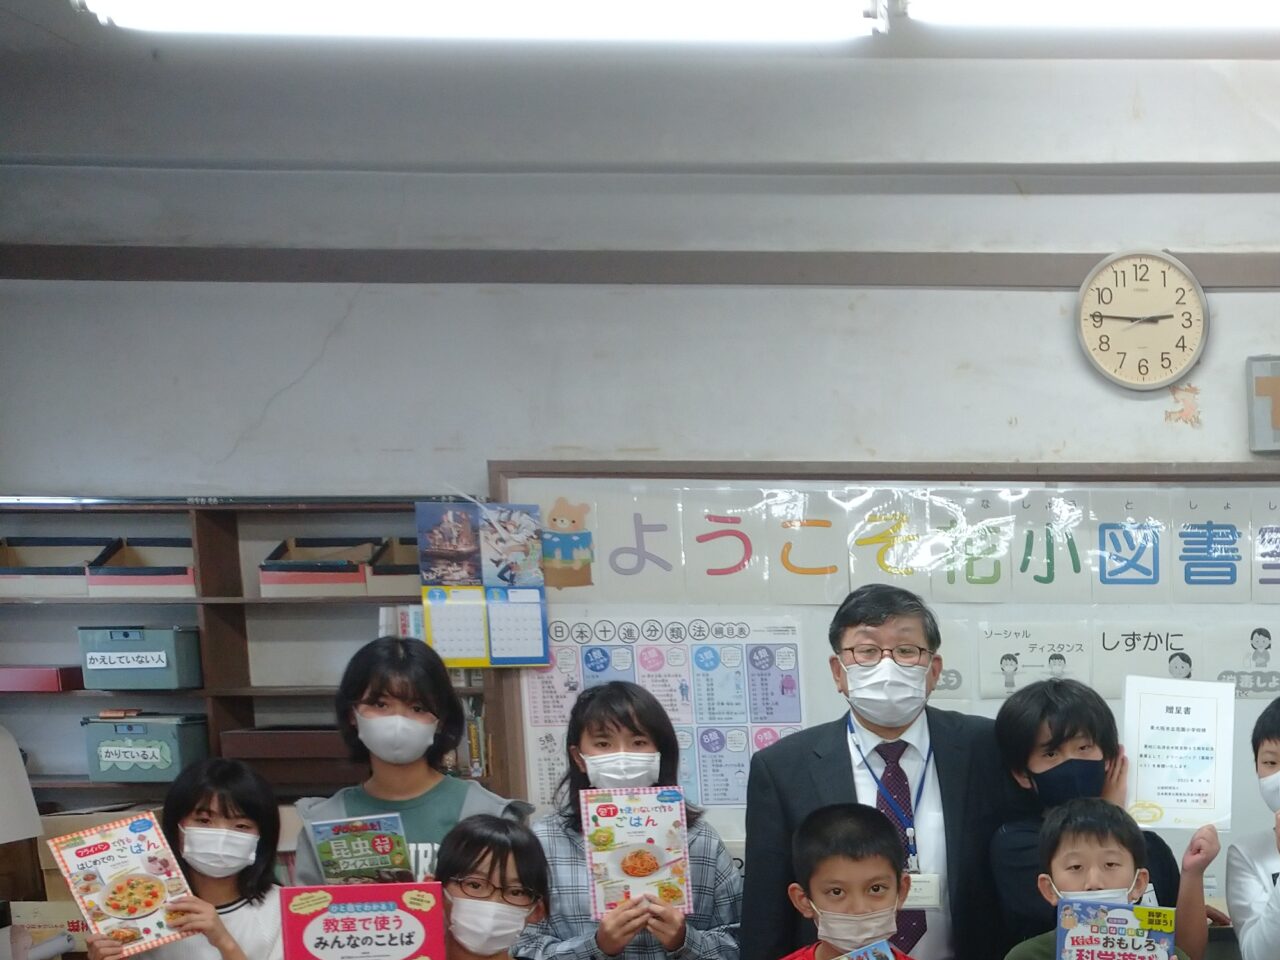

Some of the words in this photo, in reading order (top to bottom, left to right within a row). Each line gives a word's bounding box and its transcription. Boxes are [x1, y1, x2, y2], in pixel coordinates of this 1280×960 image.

[1114, 271, 1126, 288] 11
[1133, 264, 1149, 281] 12
[1161, 271, 1167, 287] 1
[1097, 288, 1113, 304] 10
[1176, 288, 1186, 305] 2
[1092, 311, 1103, 328] 9
[1181, 312, 1193, 328] 3
[1099, 335, 1111, 351] 8
[1176, 336, 1187, 351] 4
[1117, 353, 1127, 368] 7
[1138, 358, 1149, 375] 6
[1160, 352, 1171, 369] 5
[984, 630, 1031, 639] ソーシャル
[1102, 632, 1185, 651] しずかに
[1028, 644, 1084, 653] ディスタンス
[88, 654, 165, 665] かえしていない人
[104, 749, 159, 760] かりている人
[616, 815, 657, 828] ごはん
[77, 855, 114, 871] はじめての
[117, 841, 160, 859] ごはん
[330, 838, 372, 859] 昆虫
[323, 915, 403, 933] 教室で使う
[314, 931, 415, 949] みんなのことば
[1071, 936, 1100, 946] Kids
[1102, 937, 1156, 951] おもしろ
